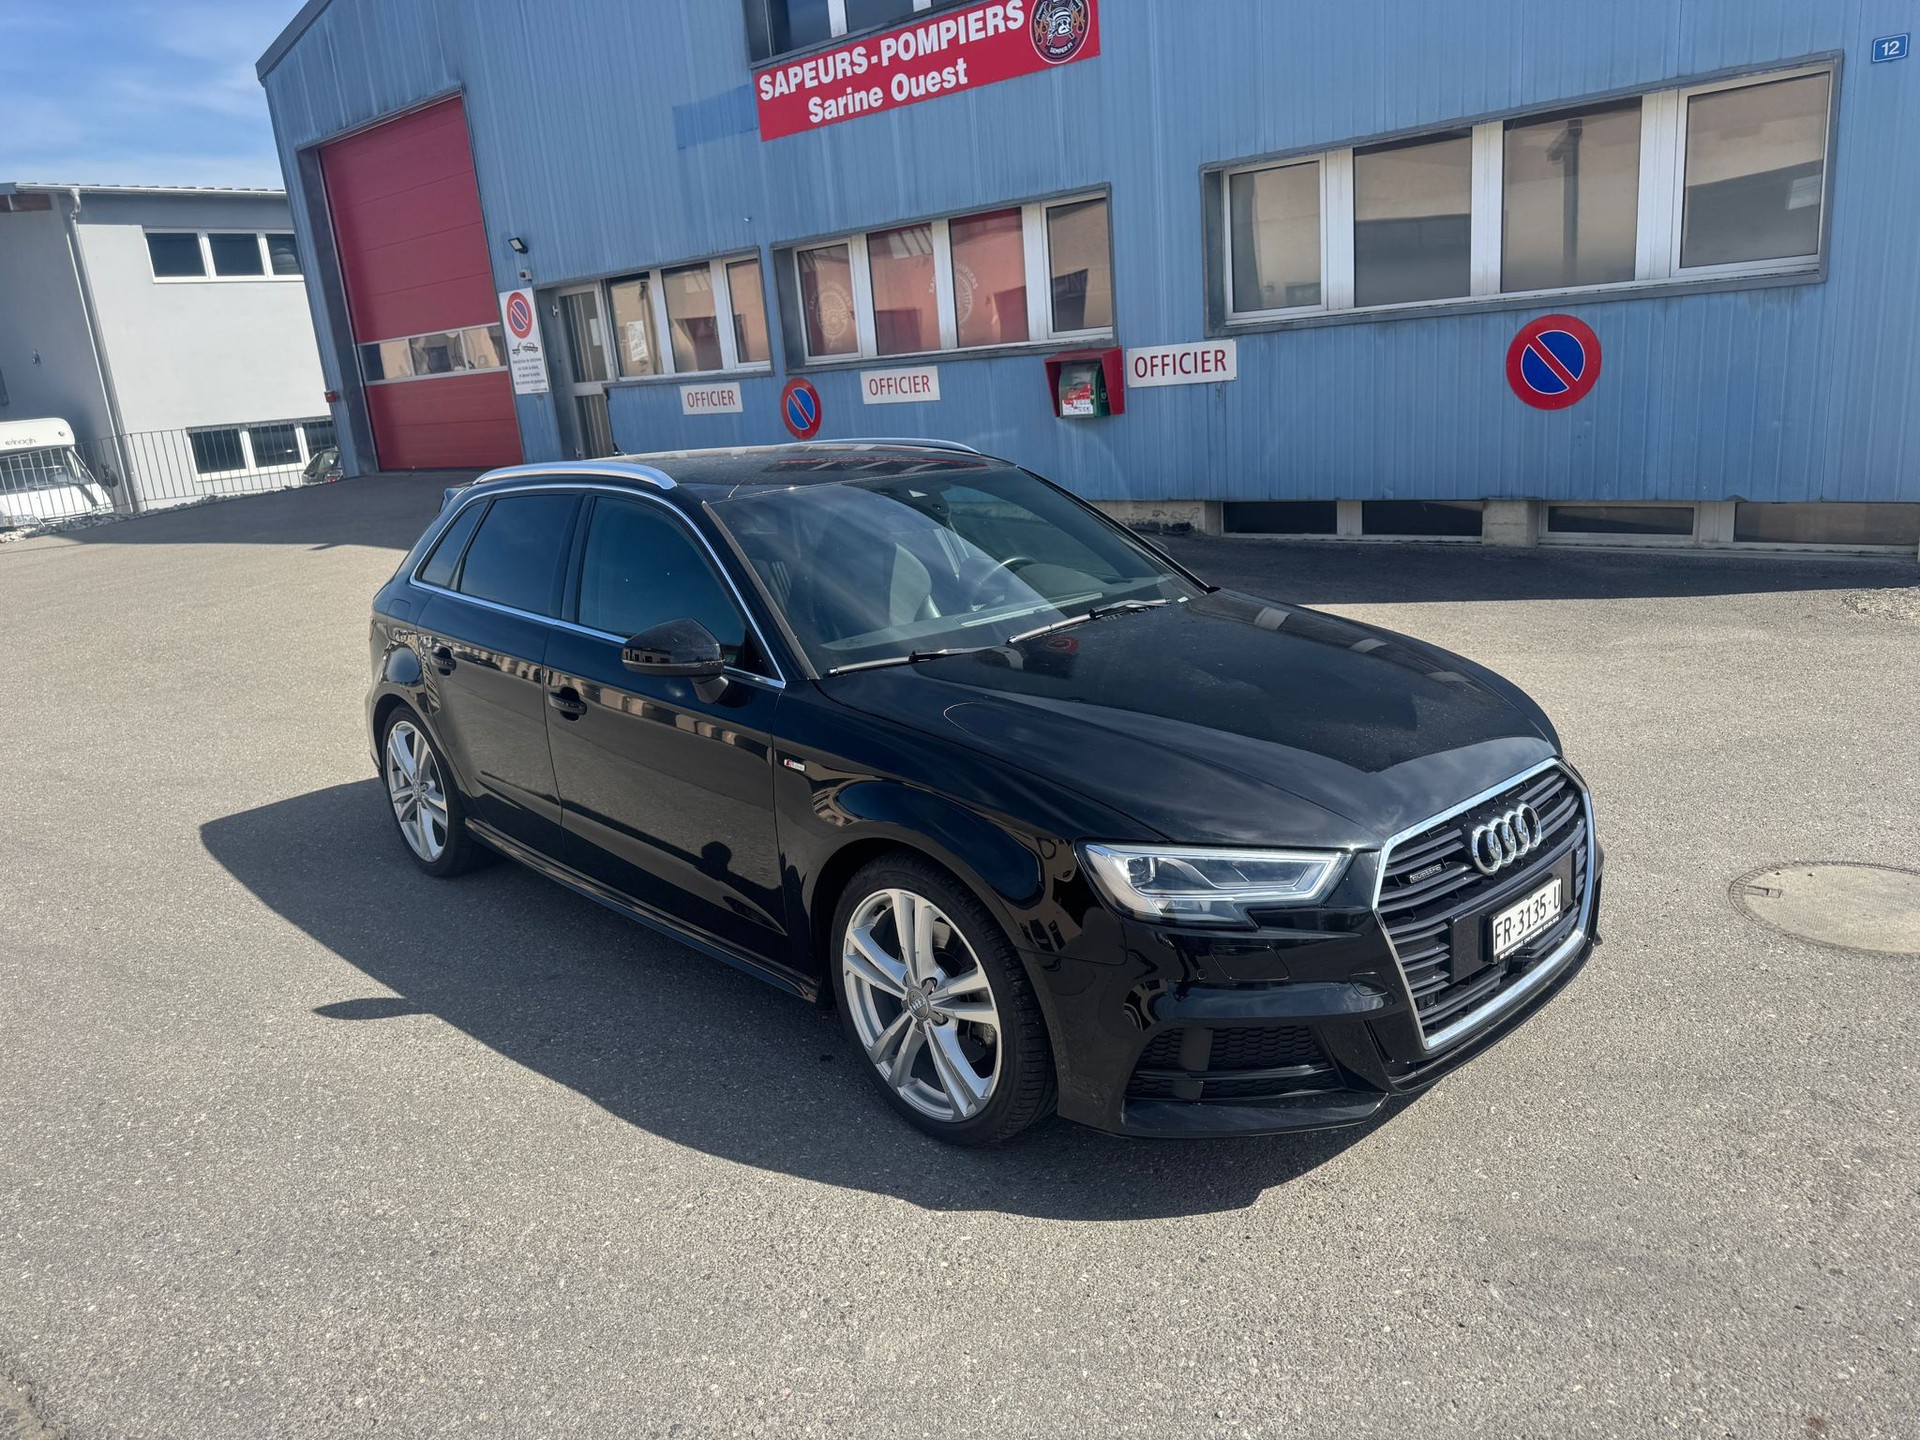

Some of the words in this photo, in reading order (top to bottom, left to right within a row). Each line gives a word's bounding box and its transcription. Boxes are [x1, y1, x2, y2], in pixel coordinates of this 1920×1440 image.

[1881, 41, 1900, 56] 12
[808, 86, 883, 123] Sarine
[891, 58, 968, 101] Ouest
[1134, 349, 1227, 379] OFFICIER
[869, 375, 931, 396] OFFICIER
[687, 389, 736, 408] OFFICIER
